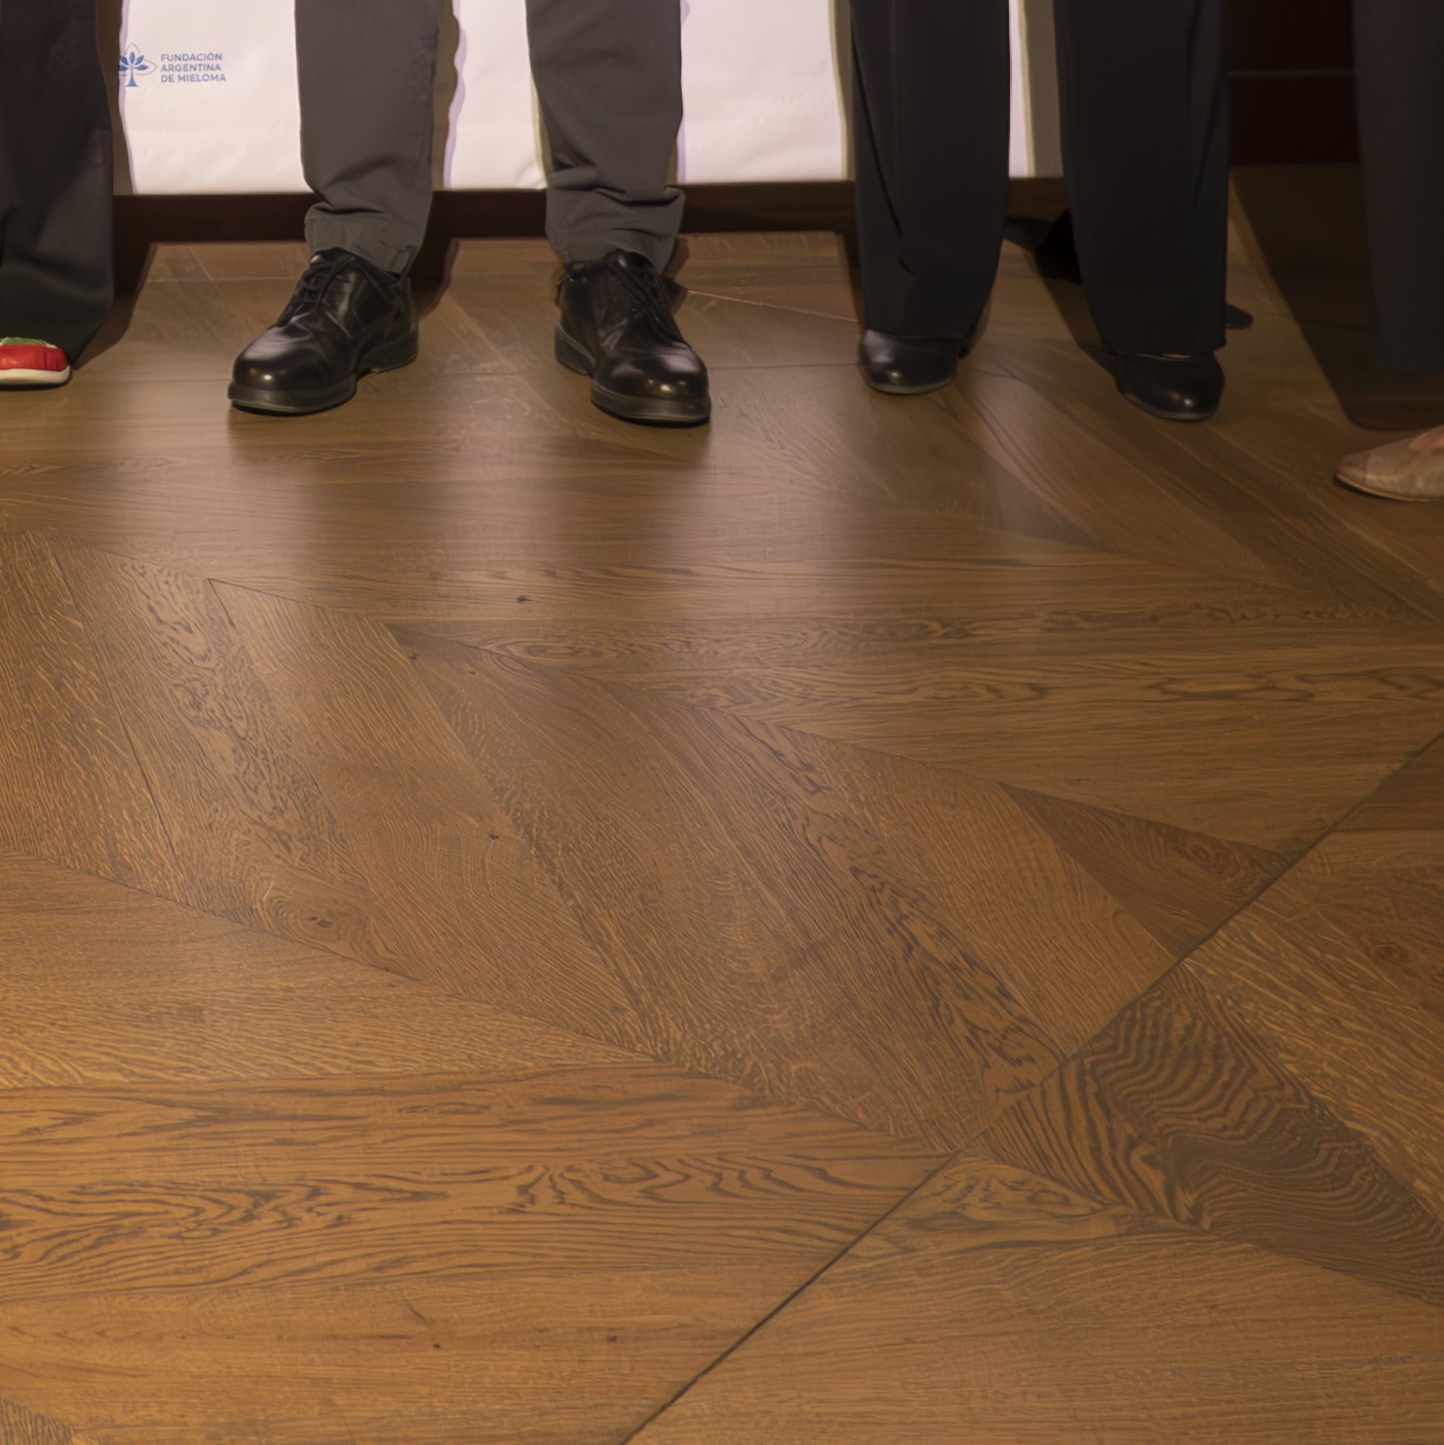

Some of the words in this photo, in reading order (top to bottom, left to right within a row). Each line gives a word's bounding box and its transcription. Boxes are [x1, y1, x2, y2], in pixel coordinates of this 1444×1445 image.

[160, 52, 224, 63] FUNDACIÓN
[160, 63, 222, 73] ARGENTINA
[160, 74, 175, 84] DE
[176, 73, 228, 84] MIELOMA
